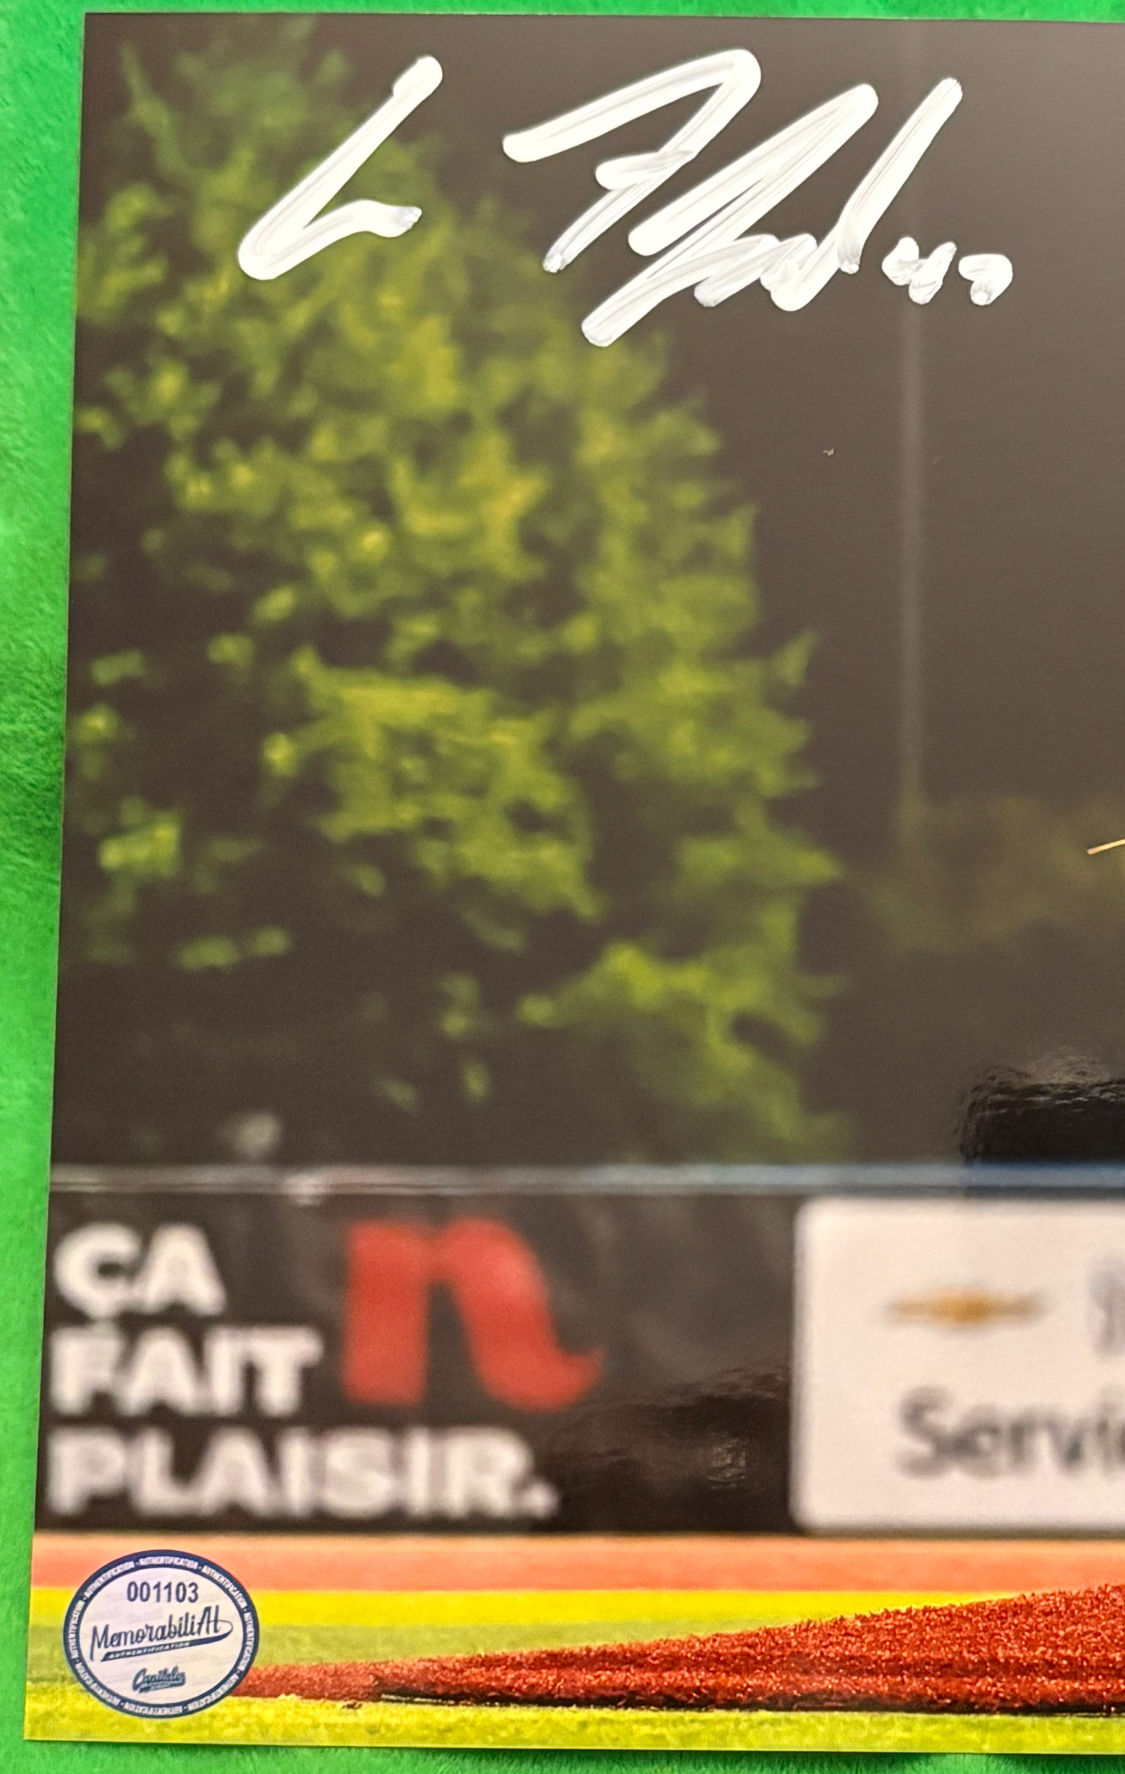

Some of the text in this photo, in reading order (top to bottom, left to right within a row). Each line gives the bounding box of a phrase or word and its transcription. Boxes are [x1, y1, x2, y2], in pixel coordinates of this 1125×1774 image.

[49, 1323, 323, 1417] FAIT
[46, 1424, 561, 1519] PLAISIR.
[127, 1581, 199, 1603] 001103
